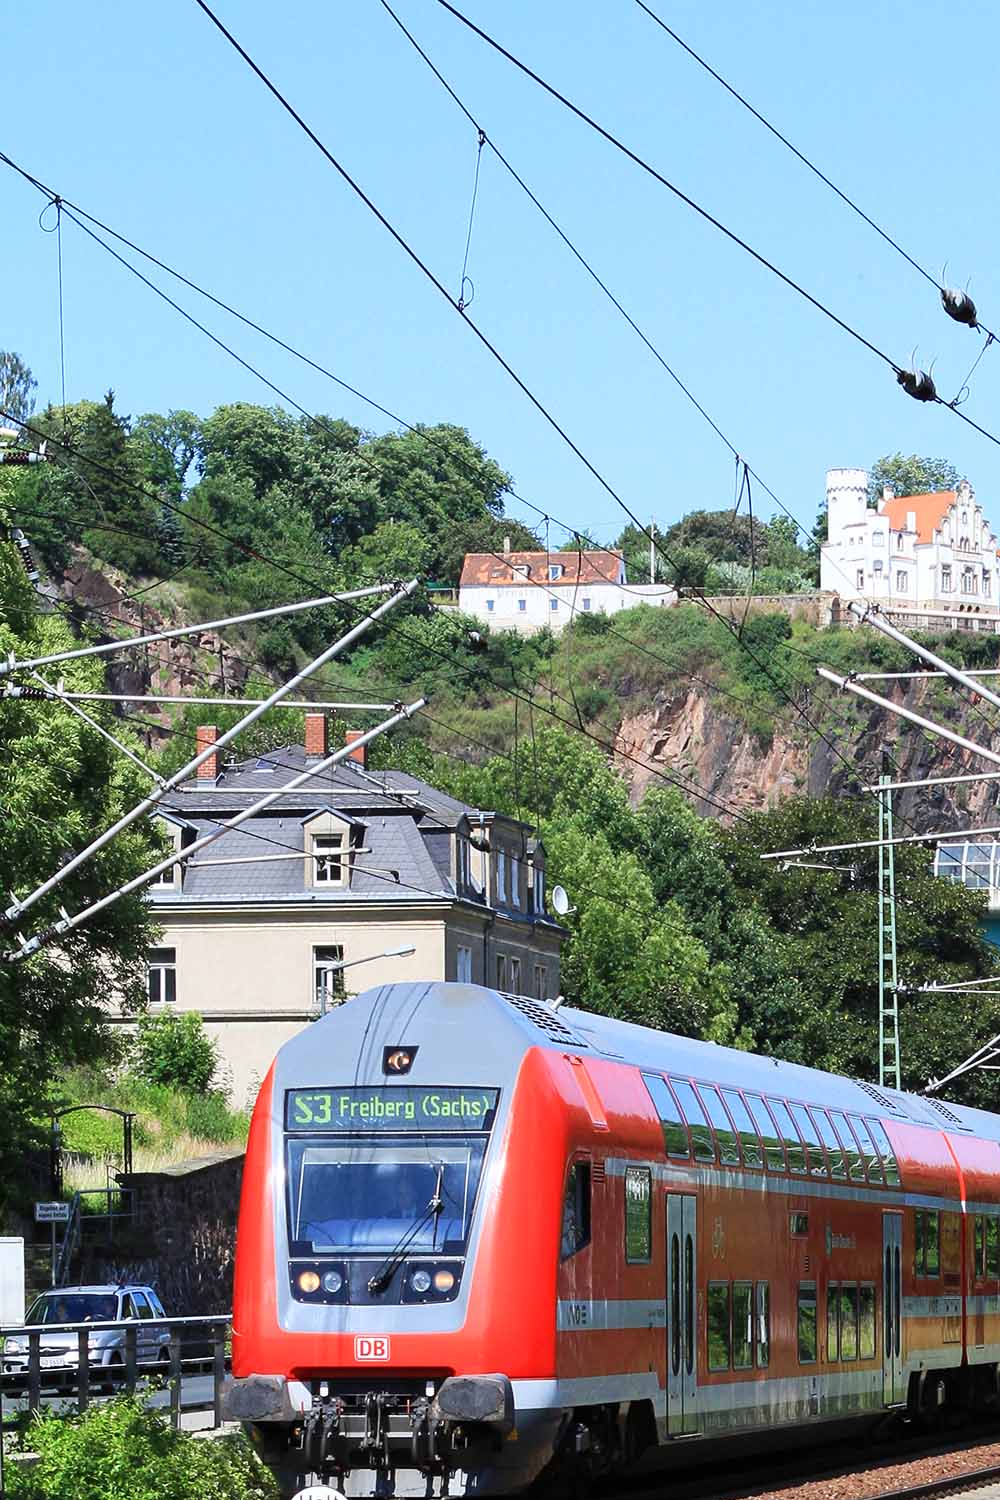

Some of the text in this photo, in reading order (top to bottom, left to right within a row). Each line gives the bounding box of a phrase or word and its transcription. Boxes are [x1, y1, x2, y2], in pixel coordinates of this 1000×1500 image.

[295, 1095, 490, 1124] S3 Freiberg (Sachs)
[360, 1340, 385, 1356] DB
